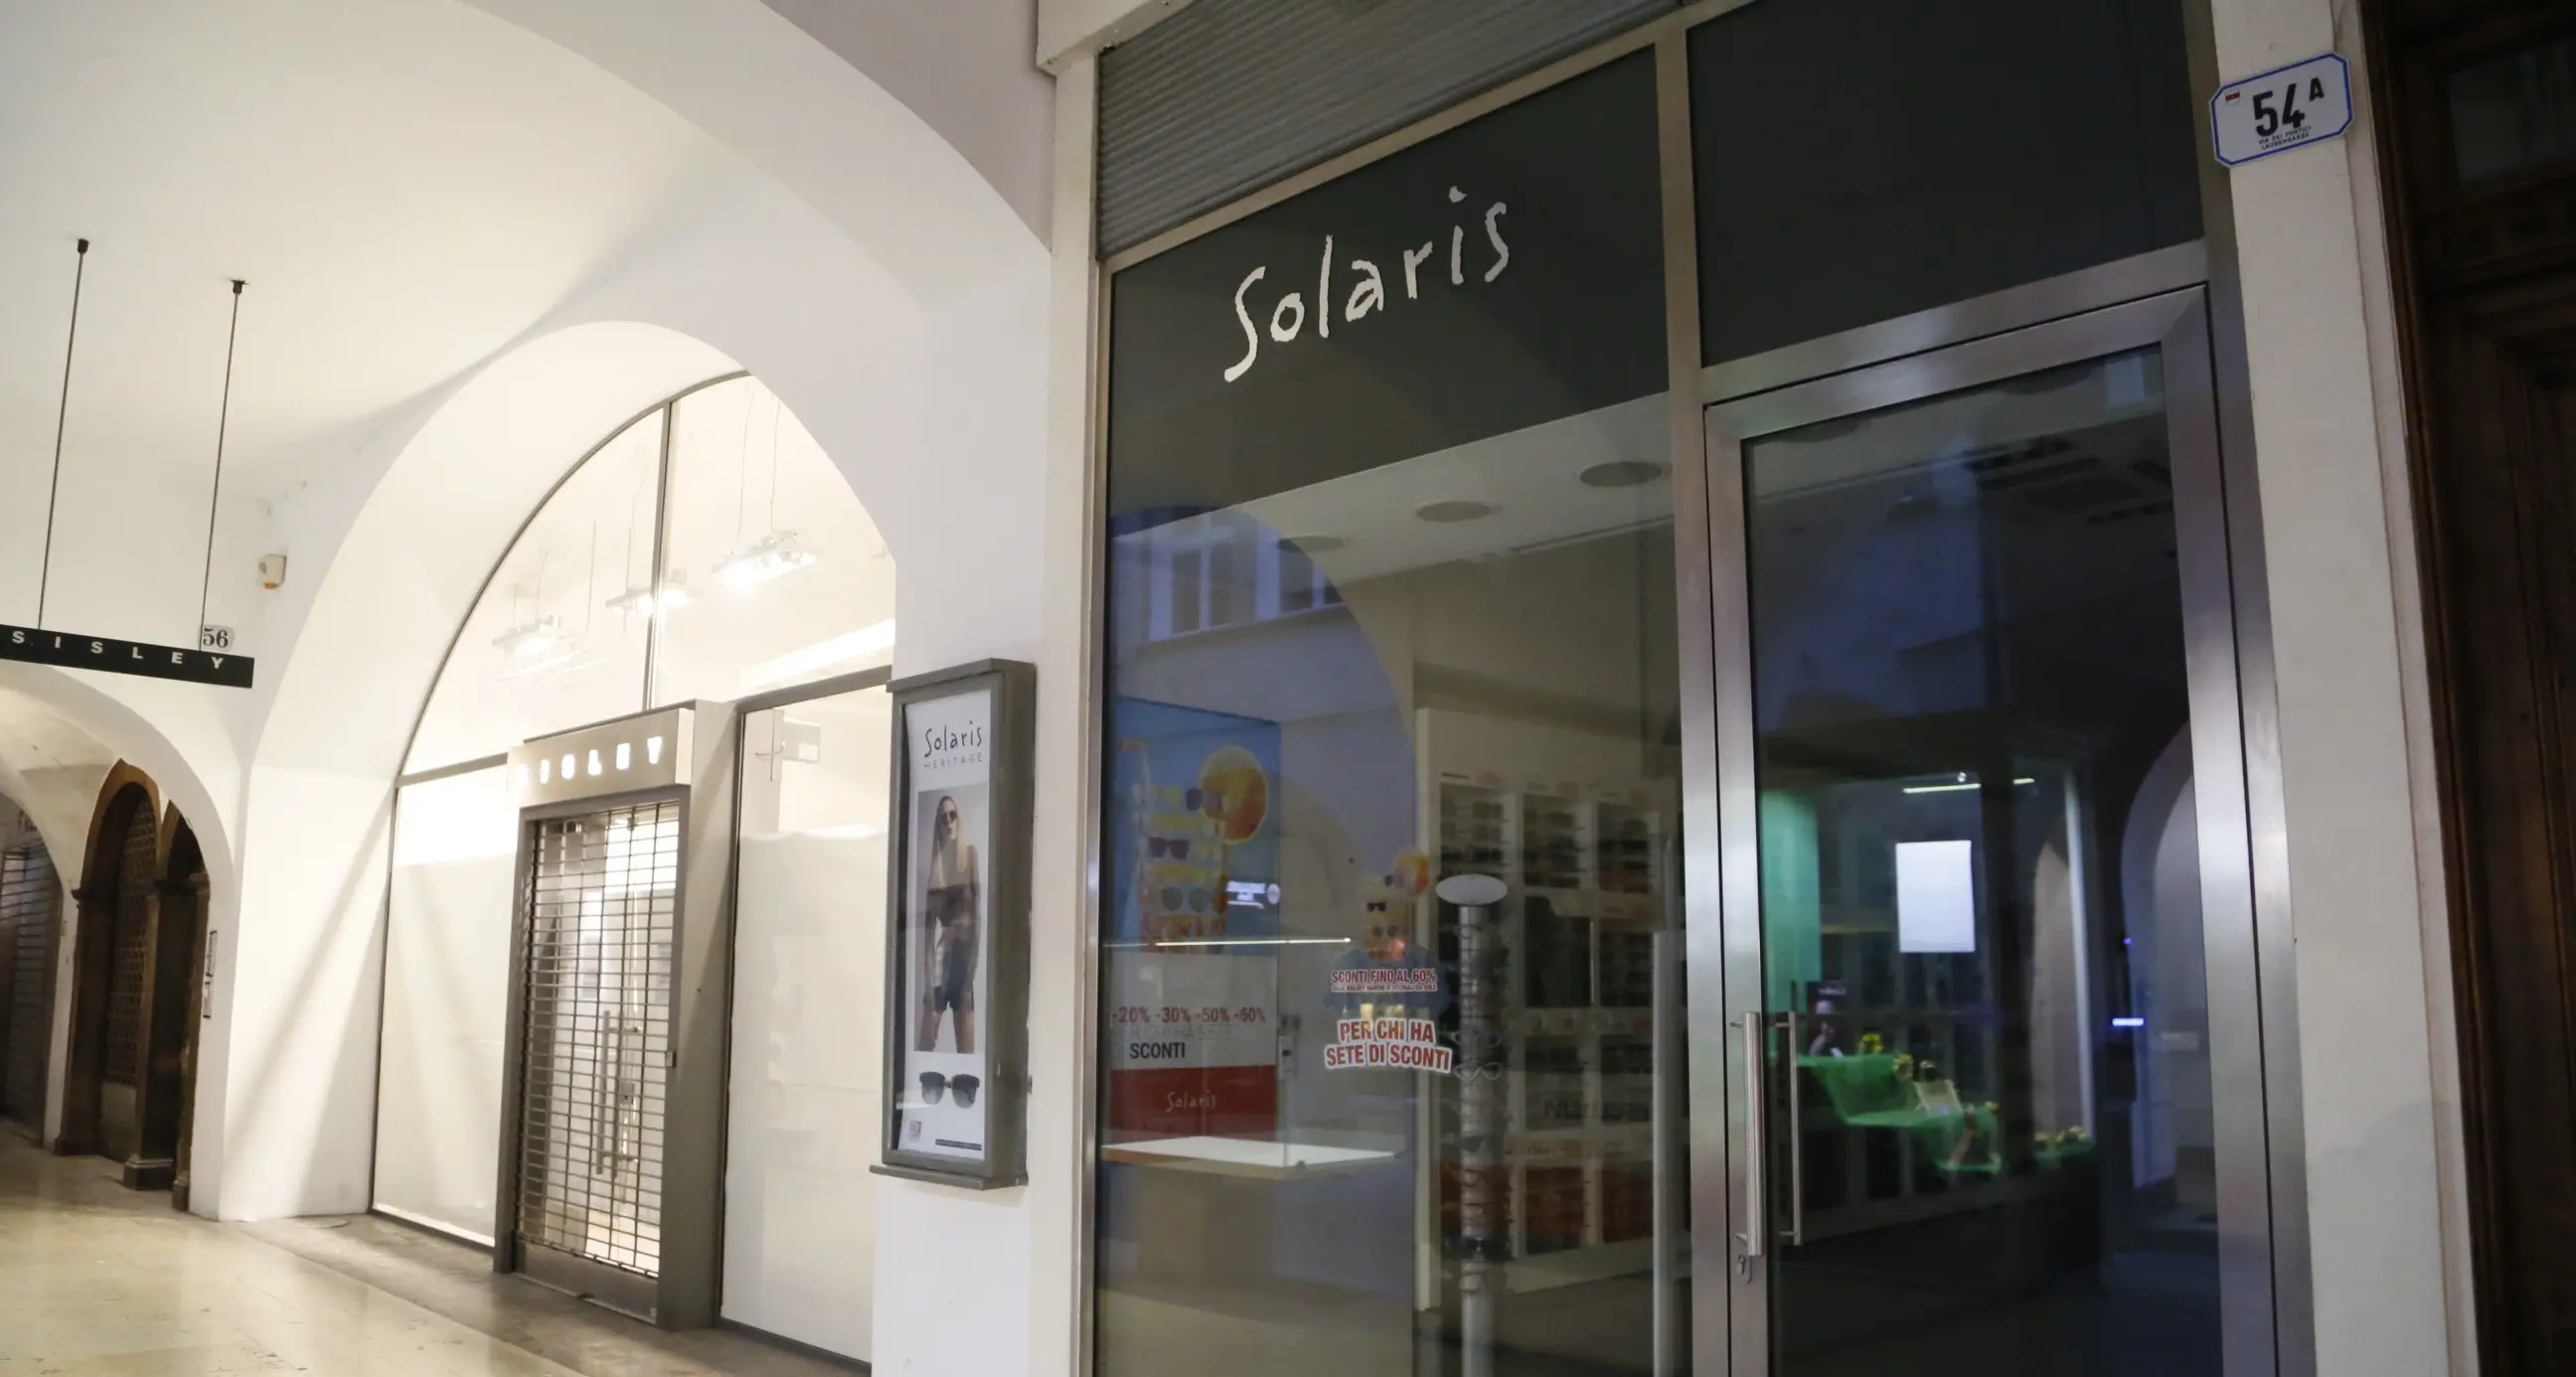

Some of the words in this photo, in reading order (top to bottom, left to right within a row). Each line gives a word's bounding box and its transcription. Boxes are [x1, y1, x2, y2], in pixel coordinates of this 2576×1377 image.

[1223, 185, 1510, 382] Solaris
[12, 630, 224, 670] SISLEY
[203, 628, 230, 649] 56
[923, 719, 983, 758] Solaris
[923, 751, 983, 771] HERITAGE
[1332, 970, 1368, 984] SCONTI
[1371, 970, 1393, 984] FINO
[1395, 969, 1410, 983] AL
[1412, 968, 1438, 984] 60%
[1112, 1005, 1151, 1023] -20%
[1156, 1005, 1192, 1023] -30%
[1197, 1006, 1230, 1023] -50%
[1233, 1005, 1266, 1023] -60%
[1339, 1019, 1371, 1041] PER
[1376, 1019, 1405, 1041] CHI
[1409, 1020, 1434, 1043] HA
[1129, 1042, 1187, 1060] SCONTI
[1326, 1044, 1365, 1067] SETE
[1368, 1043, 1386, 1064] DI
[1389, 1043, 1451, 1071] SCONTI
[1166, 1089, 1217, 1113] Solaris
